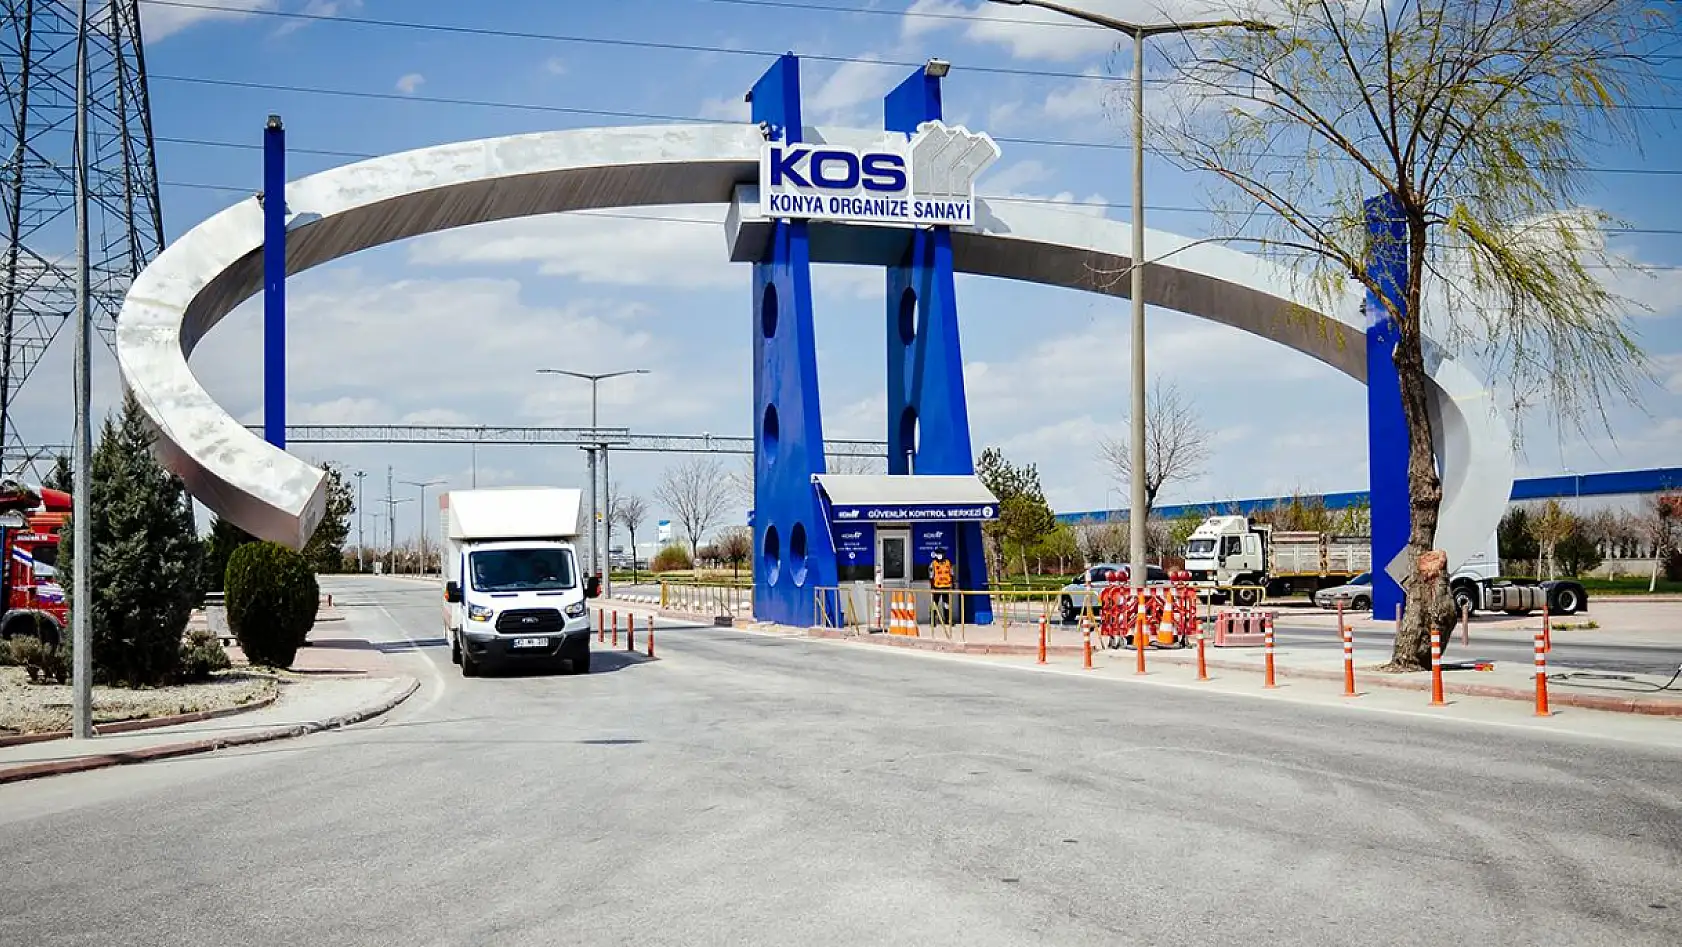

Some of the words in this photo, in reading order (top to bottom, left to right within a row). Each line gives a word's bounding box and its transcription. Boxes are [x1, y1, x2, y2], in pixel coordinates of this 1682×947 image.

[770, 147, 906, 191] KOS
[770, 194, 823, 214] KONYA
[830, 195, 908, 217] ORGANİZE
[914, 199, 971, 220] SANAYİ
[868, 508, 908, 518] GÜVENLİK
[908, 510, 946, 518] KONTROL
